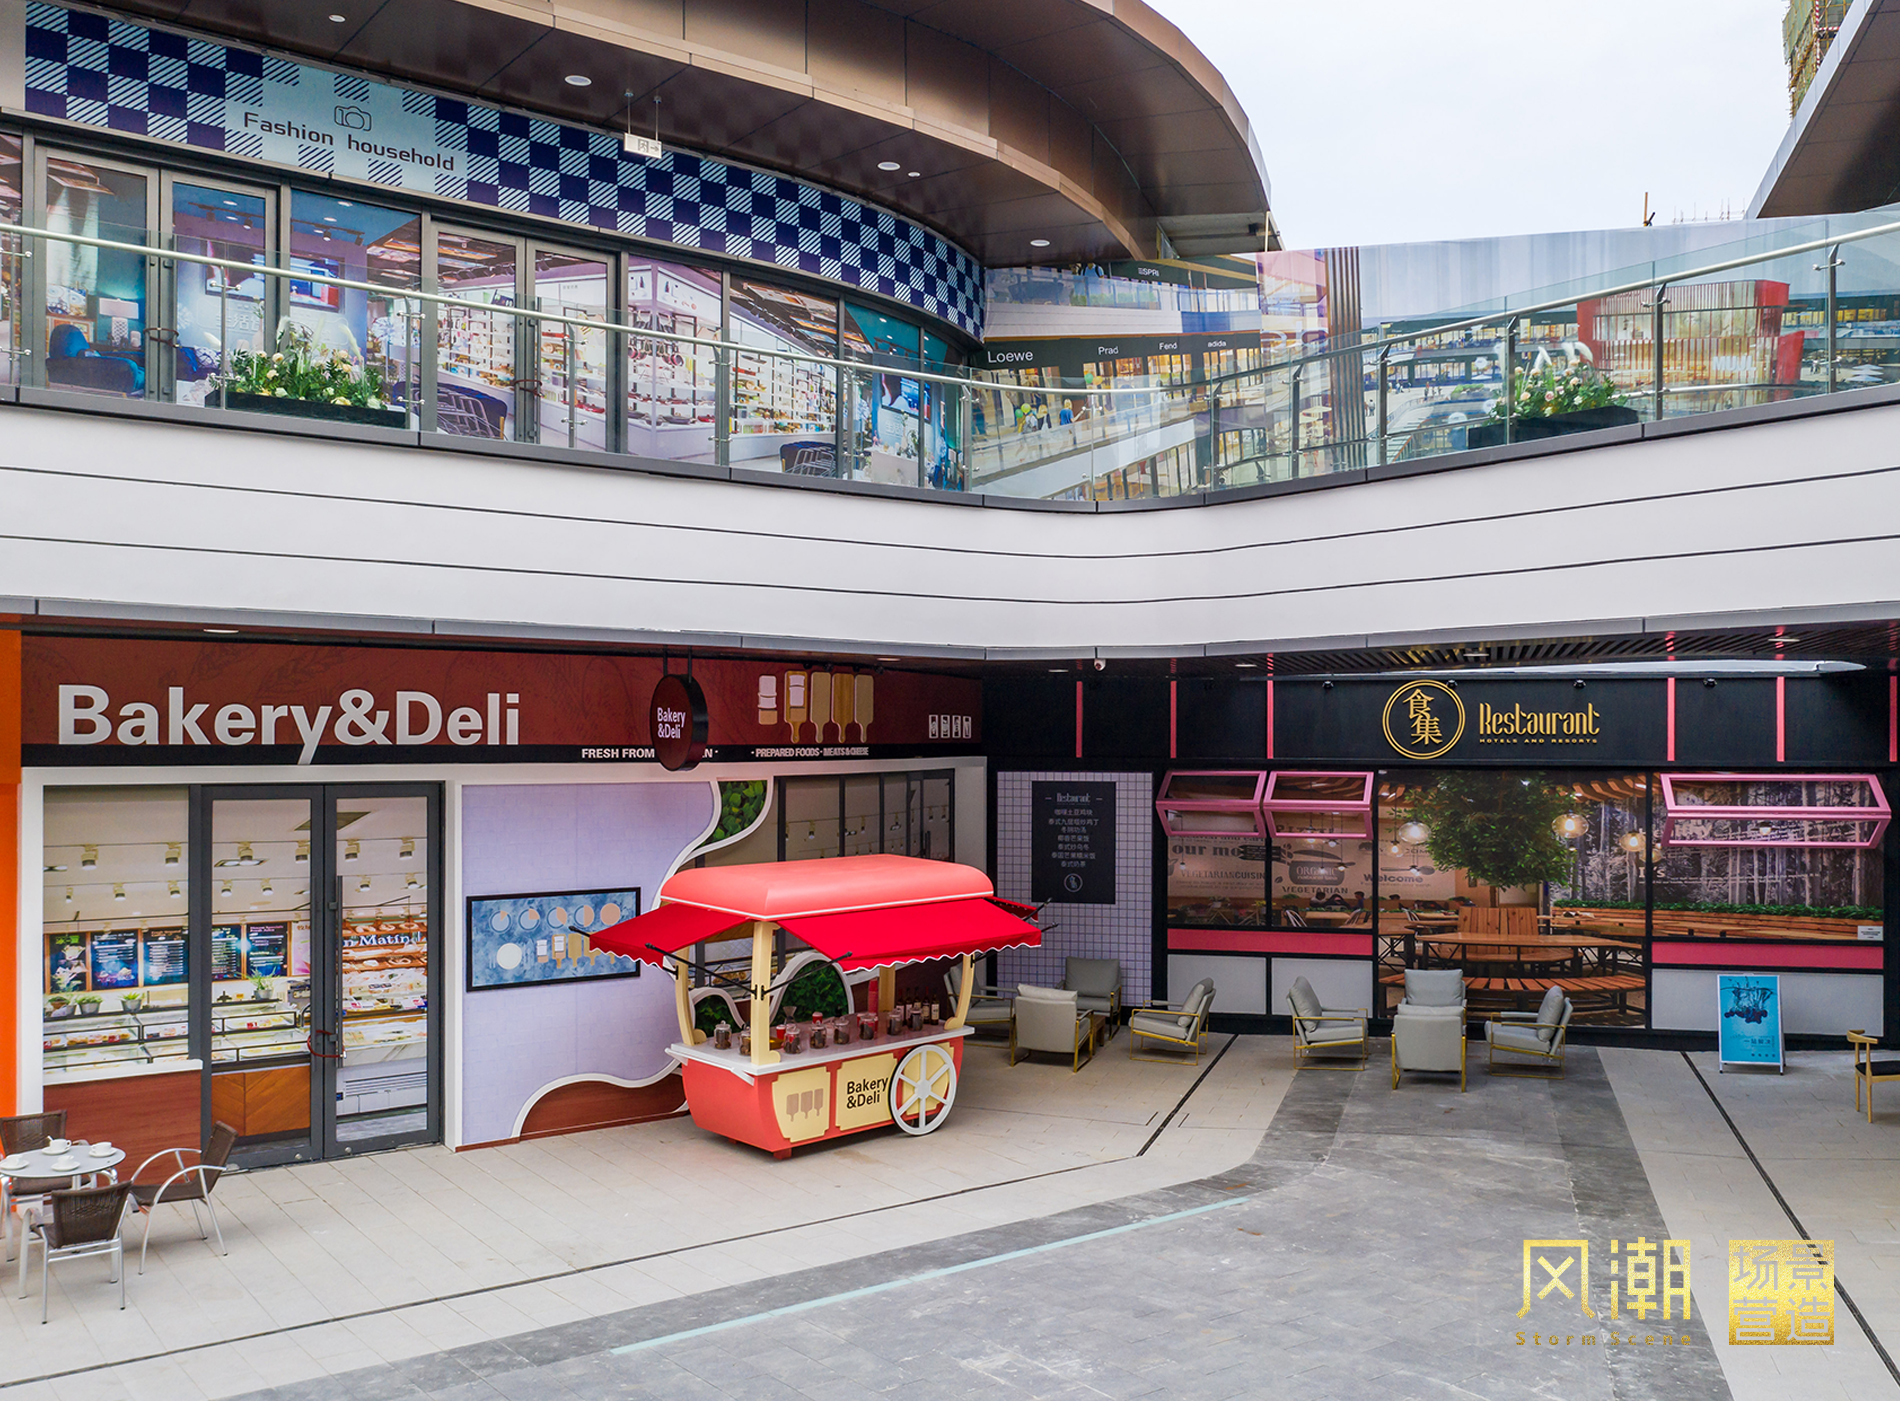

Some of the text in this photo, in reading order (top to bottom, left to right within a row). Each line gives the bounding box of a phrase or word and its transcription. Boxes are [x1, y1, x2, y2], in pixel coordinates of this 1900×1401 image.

[243, 110, 455, 172] Fashion household
[987, 350, 1034, 364] Loewe
[1098, 345, 1119, 356] Prad
[58, 684, 520, 765] Bakery&Deli
[656, 706, 687, 728] Bakery
[1402, 688, 1443, 746] 食集
[1479, 702, 1600, 736] Restaurant
[656, 722, 681, 740] &Deli
[581, 747, 656, 760] FRESH FROM
[755, 747, 795, 758] PREPARED
[795, 747, 820, 757] FOODS
[1281, 885, 1349, 895] VEGETARIAN
[847, 1077, 889, 1095] Bakery
[846, 1090, 880, 1109] &Deli
